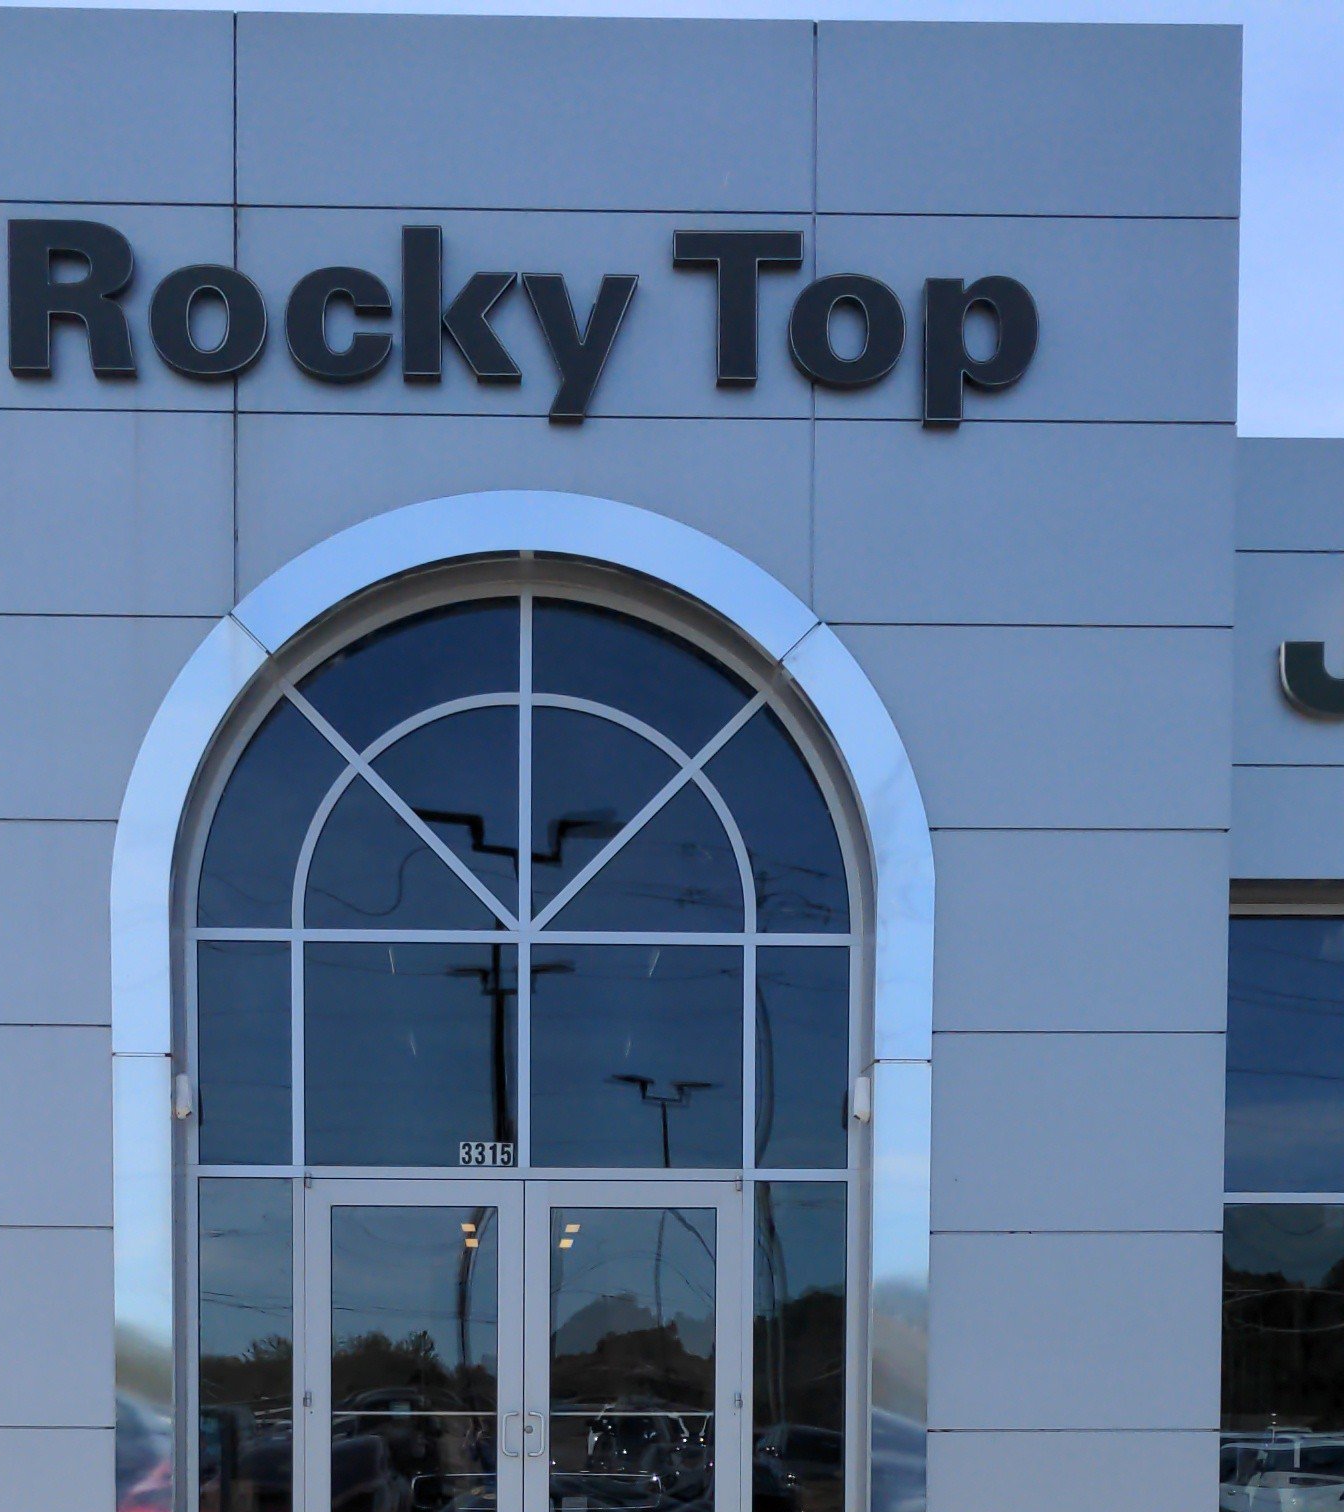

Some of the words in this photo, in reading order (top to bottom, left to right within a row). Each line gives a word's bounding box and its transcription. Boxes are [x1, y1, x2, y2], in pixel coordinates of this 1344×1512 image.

[7, 218, 640, 424] Rocky
[673, 229, 1040, 429] Top
[461, 1142, 512, 1166] 3315
